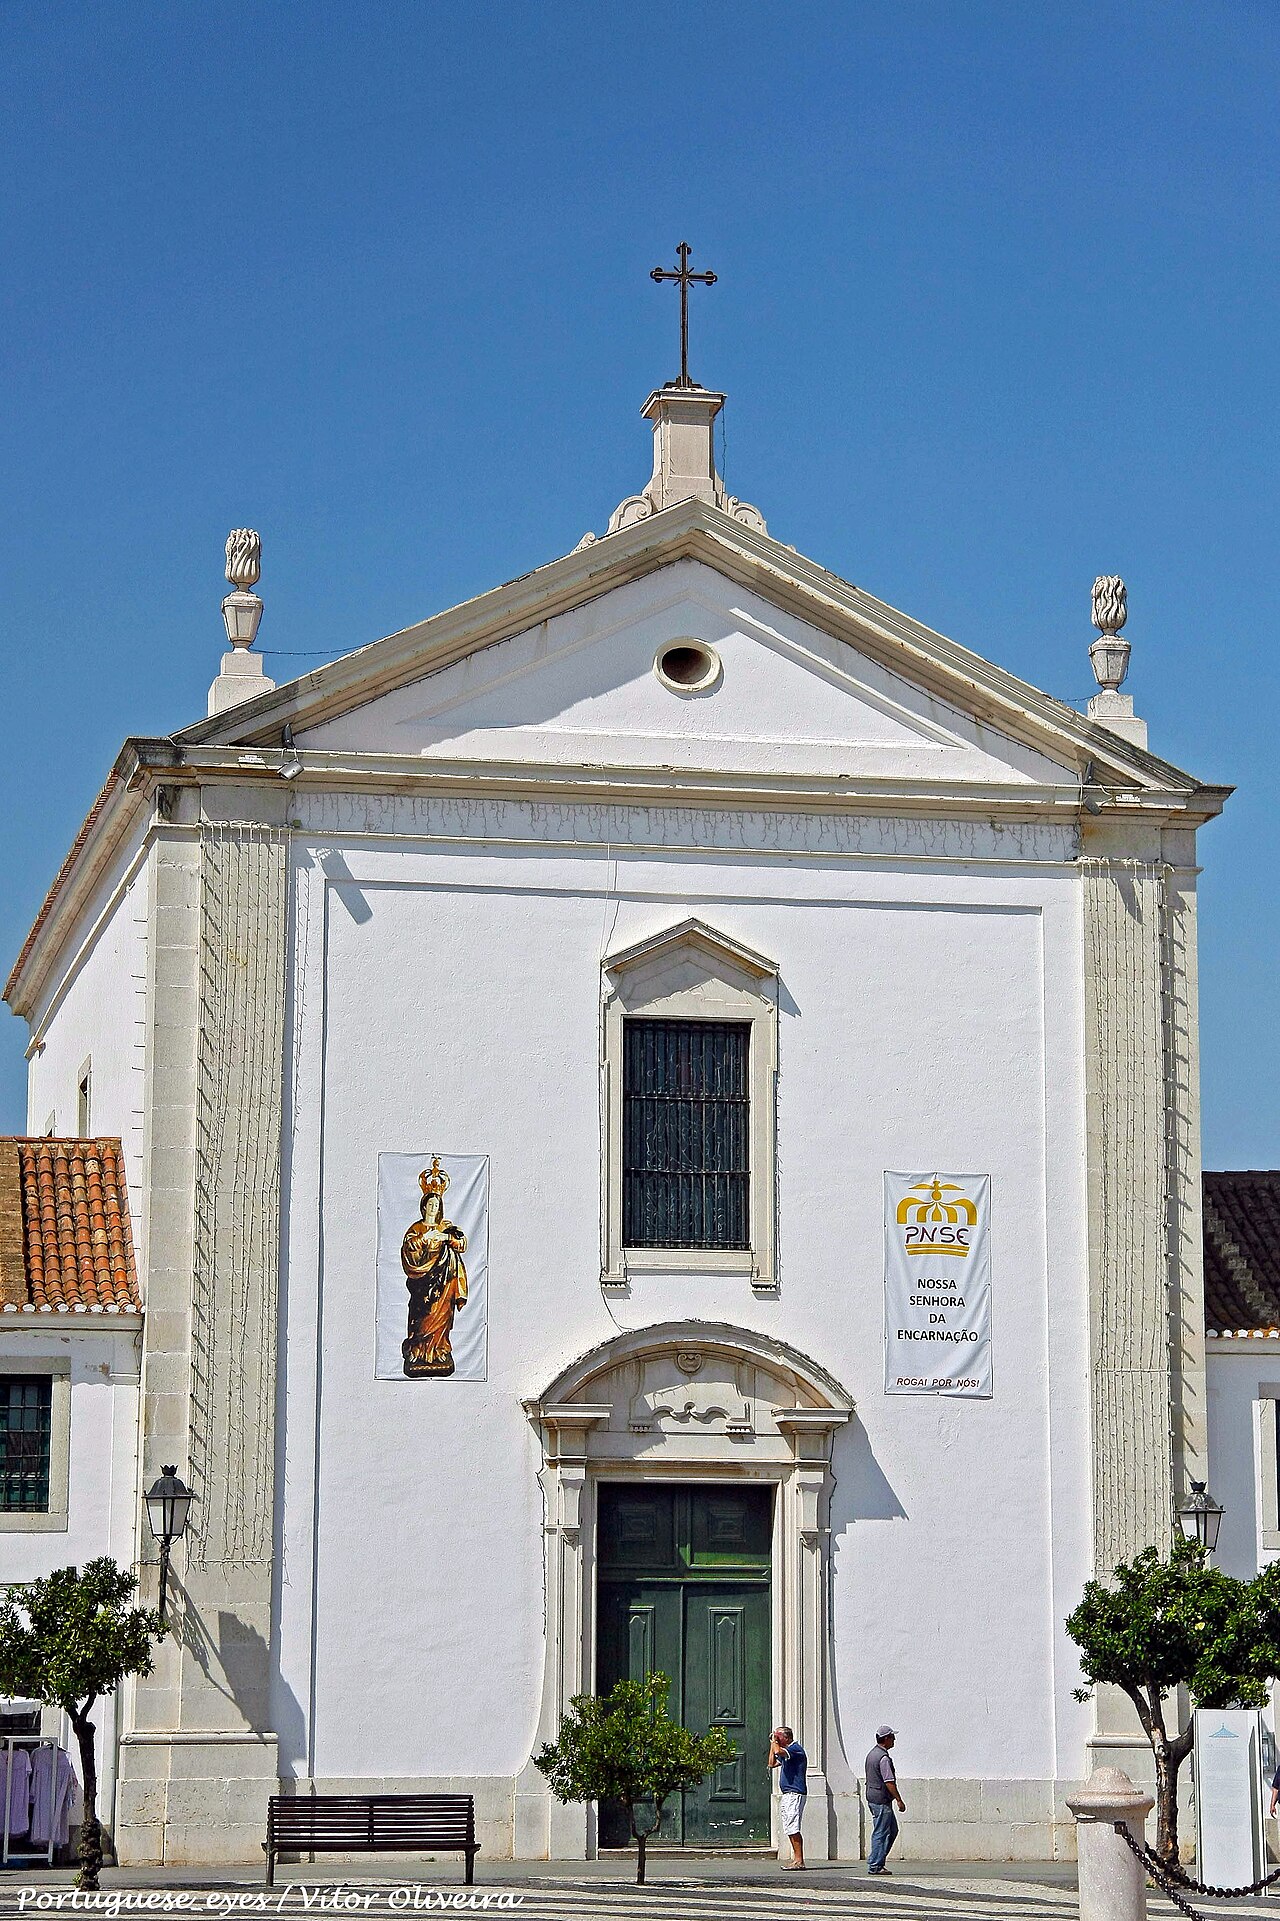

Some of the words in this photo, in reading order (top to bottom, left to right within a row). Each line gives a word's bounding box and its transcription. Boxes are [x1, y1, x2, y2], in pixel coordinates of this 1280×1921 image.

[905, 1226, 969, 1246] PNSE
[917, 1278, 957, 1290] NOSSA
[909, 1295, 966, 1308] SENHORA
[929, 1313, 946, 1324] DA
[897, 1329, 978, 1344] ENCARNAÇÃO
[896, 1377, 928, 1387] ROGAI
[931, 1378, 952, 1388] POR
[956, 1377, 980, 1388] NÓS!
